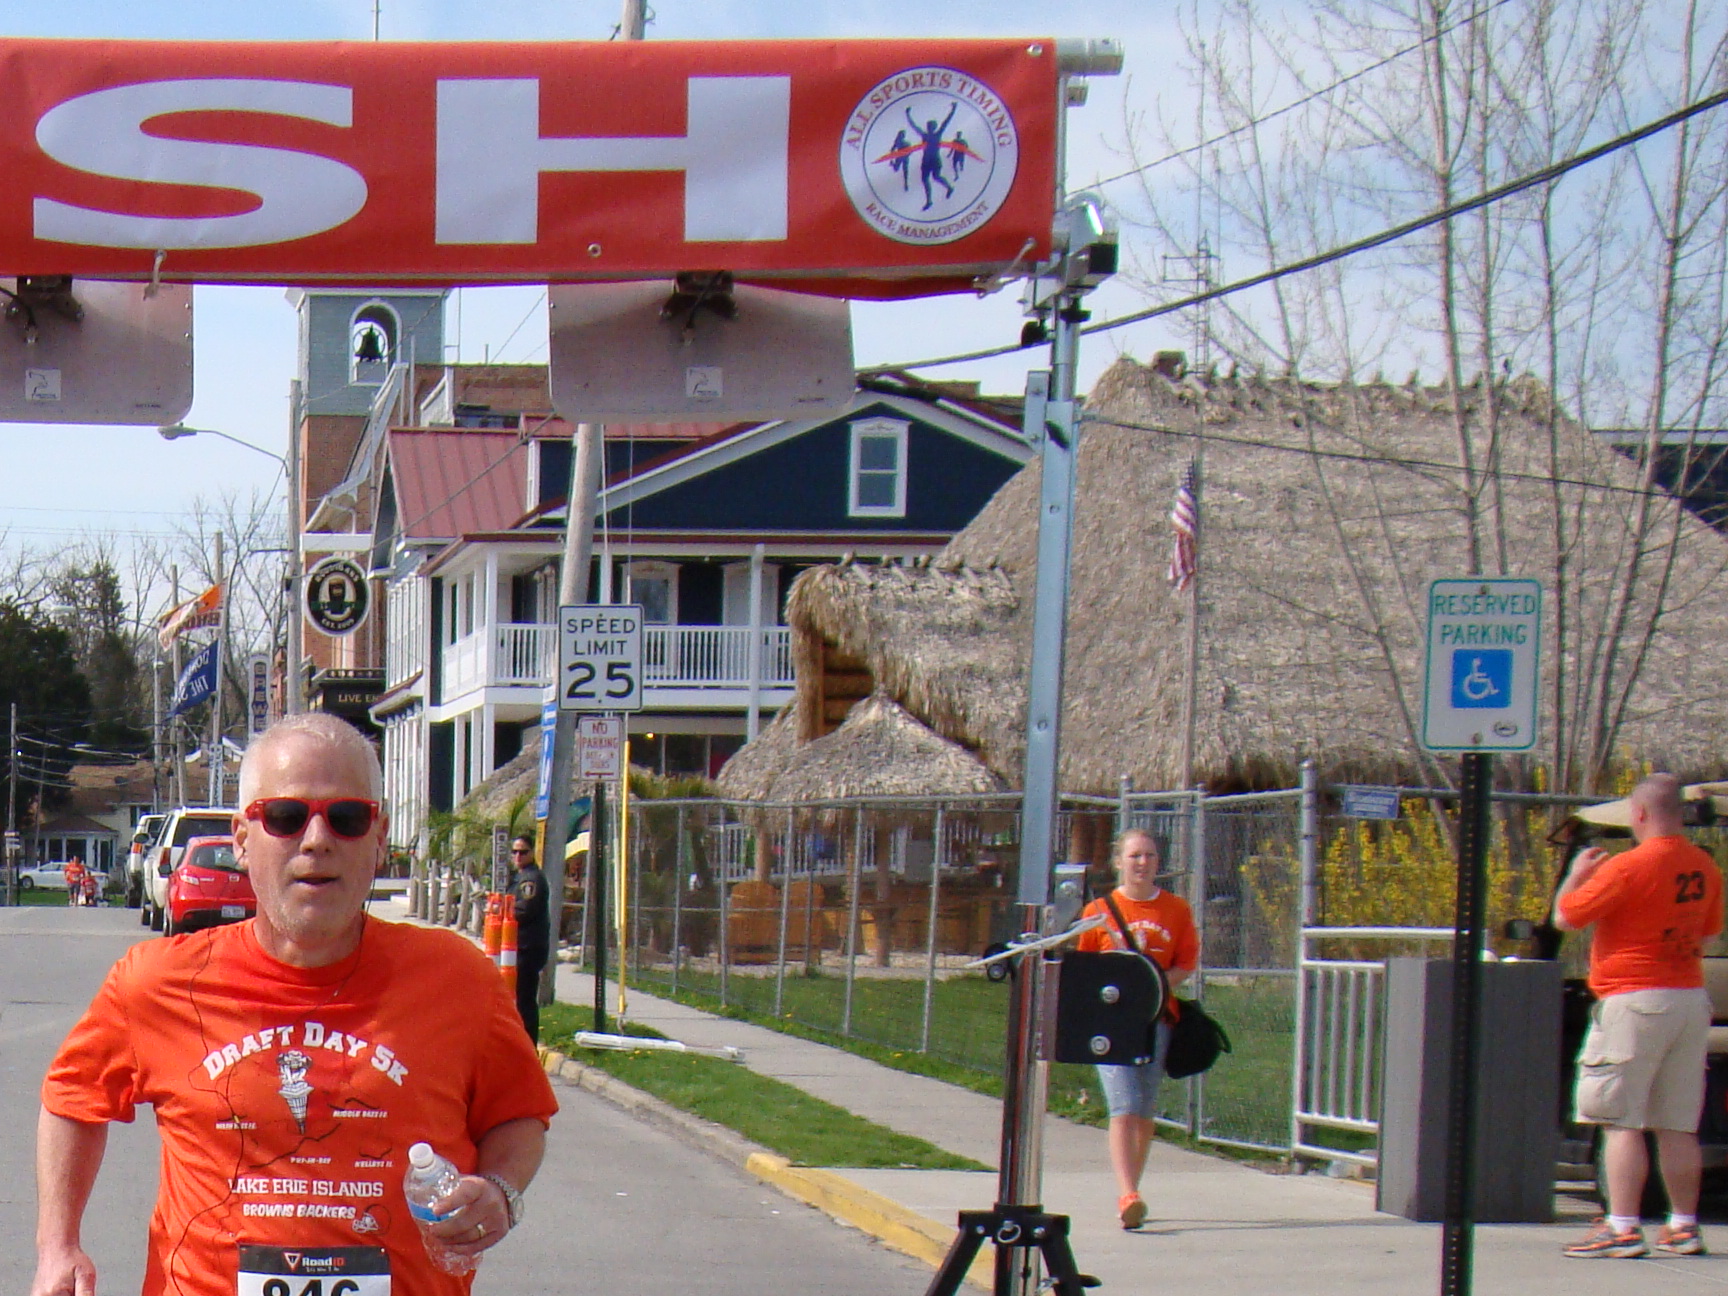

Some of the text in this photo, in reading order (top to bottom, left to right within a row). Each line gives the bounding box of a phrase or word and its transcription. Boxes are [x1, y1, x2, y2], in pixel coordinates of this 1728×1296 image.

[846, 72, 1012, 150] ALL SPORTS TIMING
[865, 201, 989, 239] RACE MANAGEMENT
[1433, 594, 1536, 616] RESERVED
[566, 619, 636, 634] SPEED
[1441, 624, 1528, 645] PARKING
[574, 640, 627, 656] LIMIT
[566, 661, 635, 699] 25
[338, 693, 362, 703] LIVE
[592, 722, 608, 735] NO
[582, 737, 618, 749] PARKING
[1675, 871, 1705, 904] 23
[203, 1025, 294, 1081] DRAFT
[302, 1021, 368, 1058] DAY
[228, 1178, 384, 1198] LAKE ERIE ISLANDS
[242, 1203, 357, 1220] BROWNS BACKERS
[301, 1256, 346, 1267] RoadID
